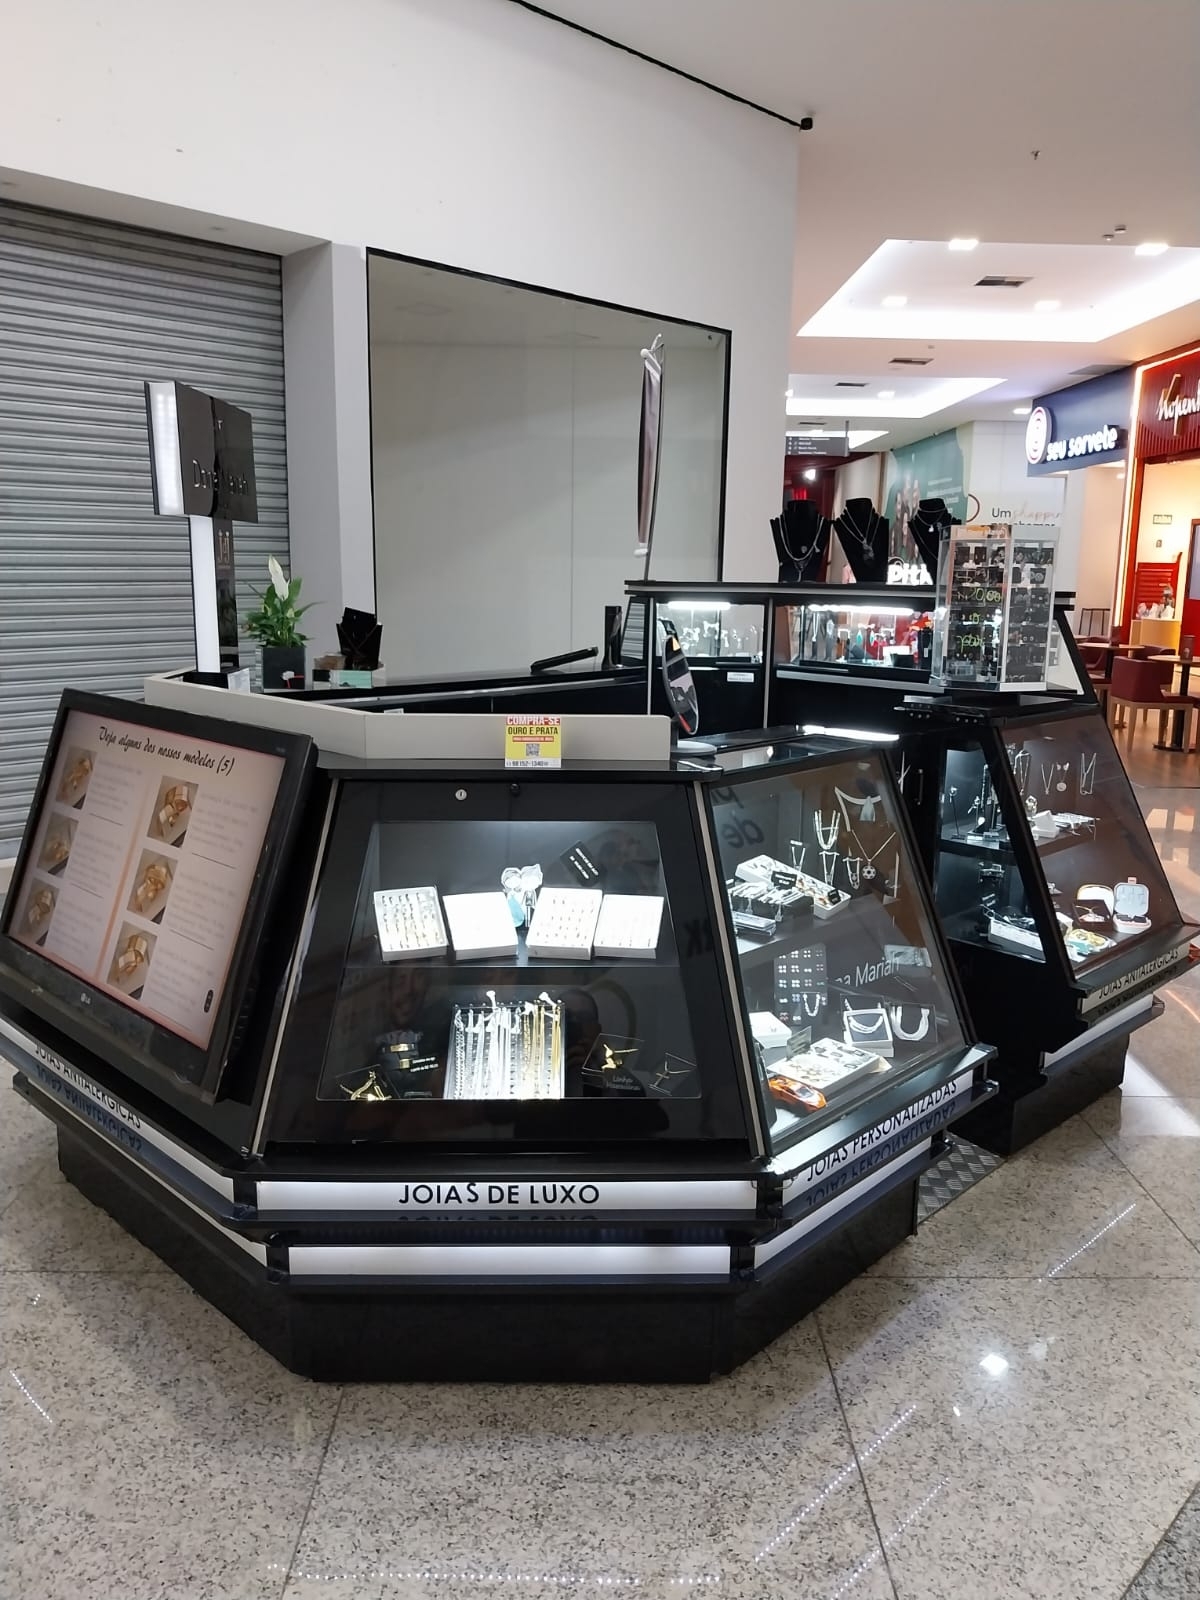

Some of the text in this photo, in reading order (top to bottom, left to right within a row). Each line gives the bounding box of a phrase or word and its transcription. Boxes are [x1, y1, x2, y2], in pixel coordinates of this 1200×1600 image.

[1046, 424, 1118, 461] seu sorvete
[991, 507, 1012, 519] Um
[507, 726, 559, 735] OURO E PRATA
[99, 726, 235, 777] Veja alguns dos nossos modelos (5)
[806, 1078, 958, 1182] JOIAS PERSONALIZADAS
[398, 1182, 600, 1205] JOIAS DE LUXO
